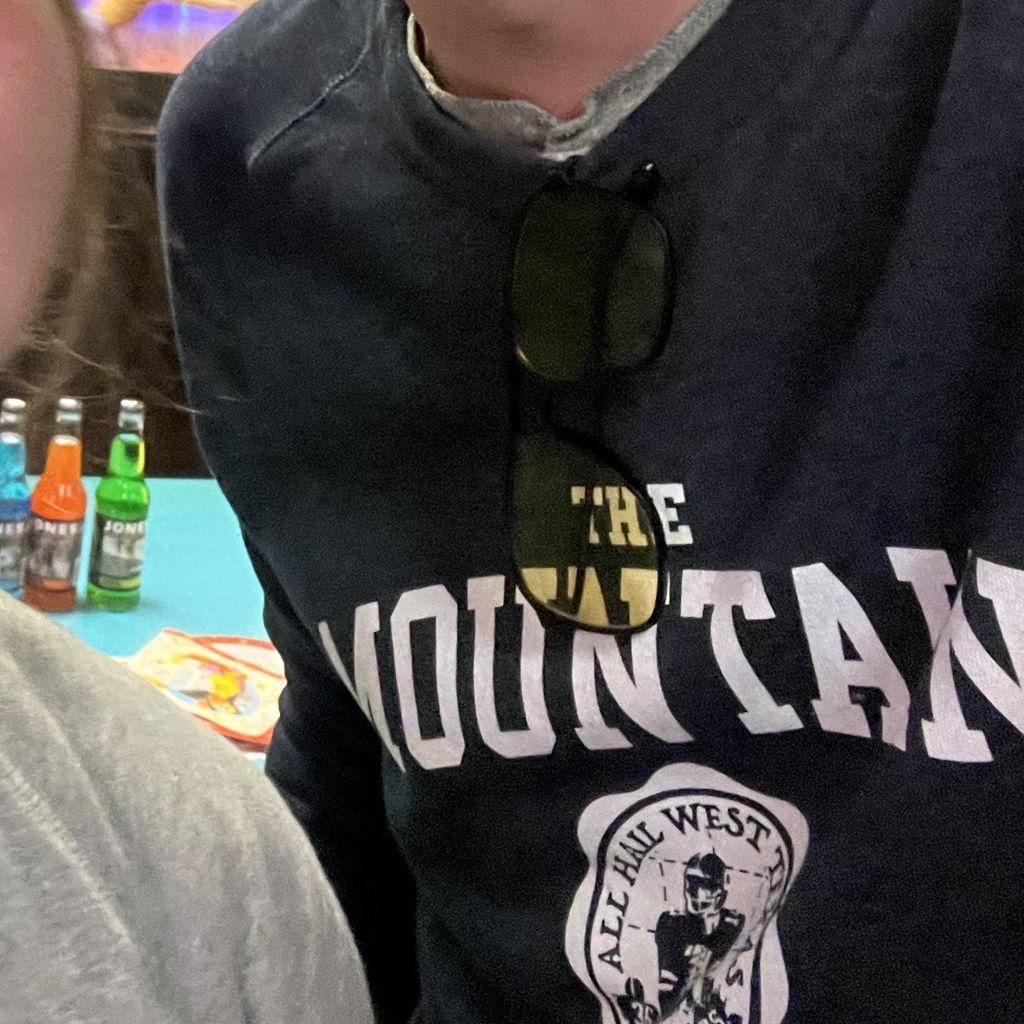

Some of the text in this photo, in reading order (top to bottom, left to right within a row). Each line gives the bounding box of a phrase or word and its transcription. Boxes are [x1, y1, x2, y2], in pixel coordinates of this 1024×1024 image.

[571, 483, 694, 546] THE
[612, 821, 665, 887] HAIL
[660, 803, 772, 853] WEST
[598, 891, 629, 974] ALL
